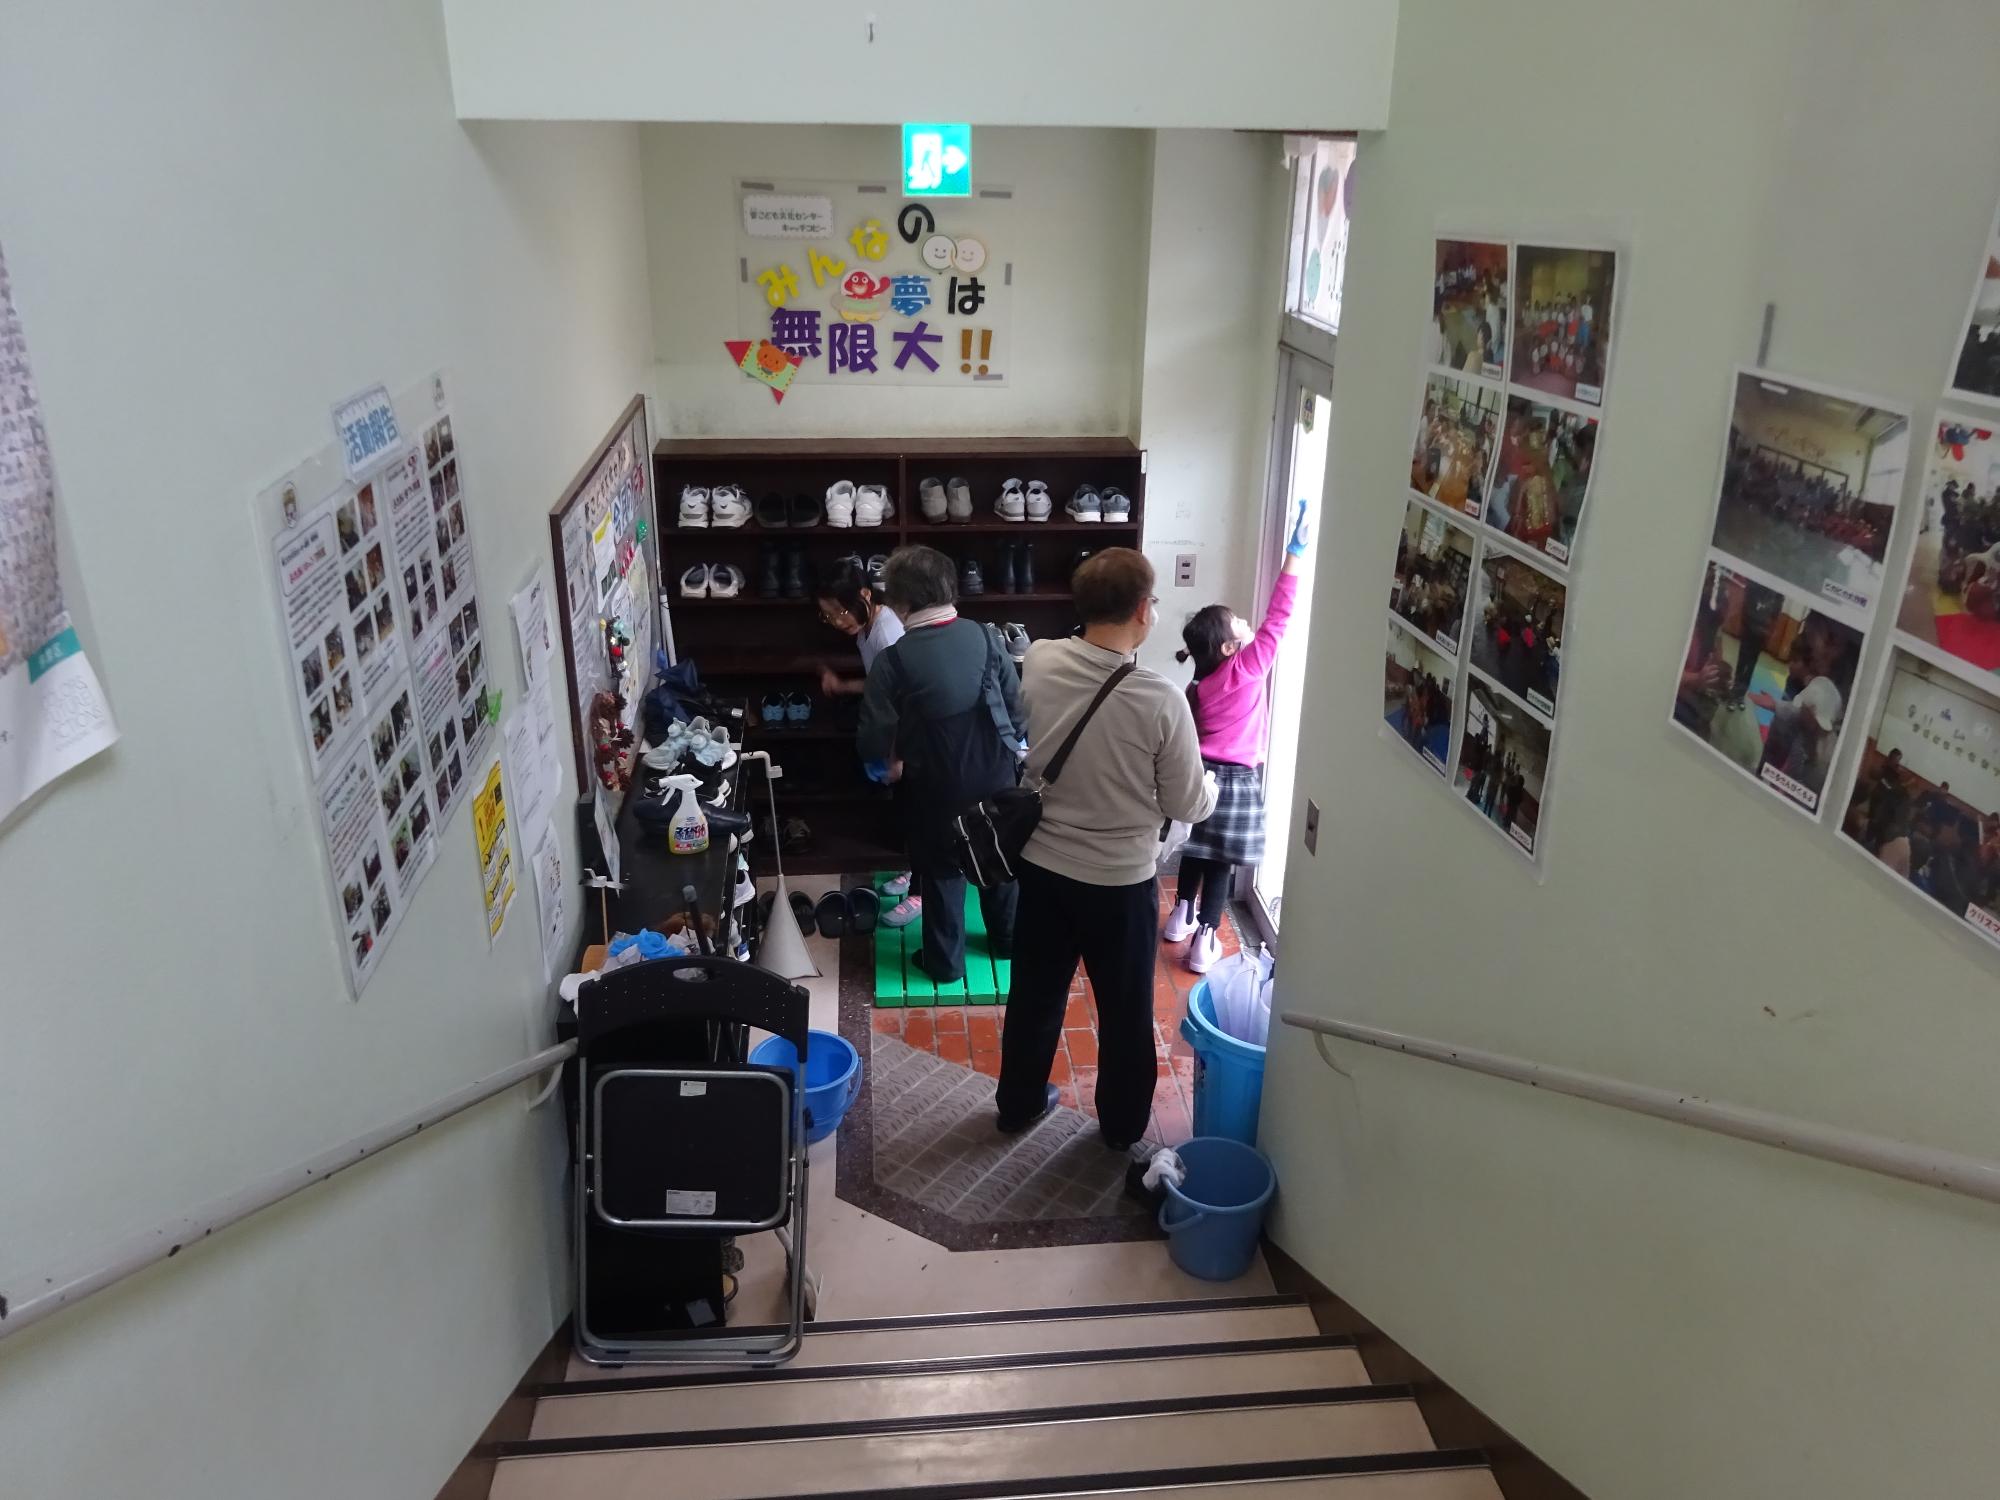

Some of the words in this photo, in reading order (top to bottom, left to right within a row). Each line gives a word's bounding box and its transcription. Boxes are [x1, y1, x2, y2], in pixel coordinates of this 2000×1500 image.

[890, 274, 986, 318] 夢は
[342, 404, 399, 465] 活動報告
